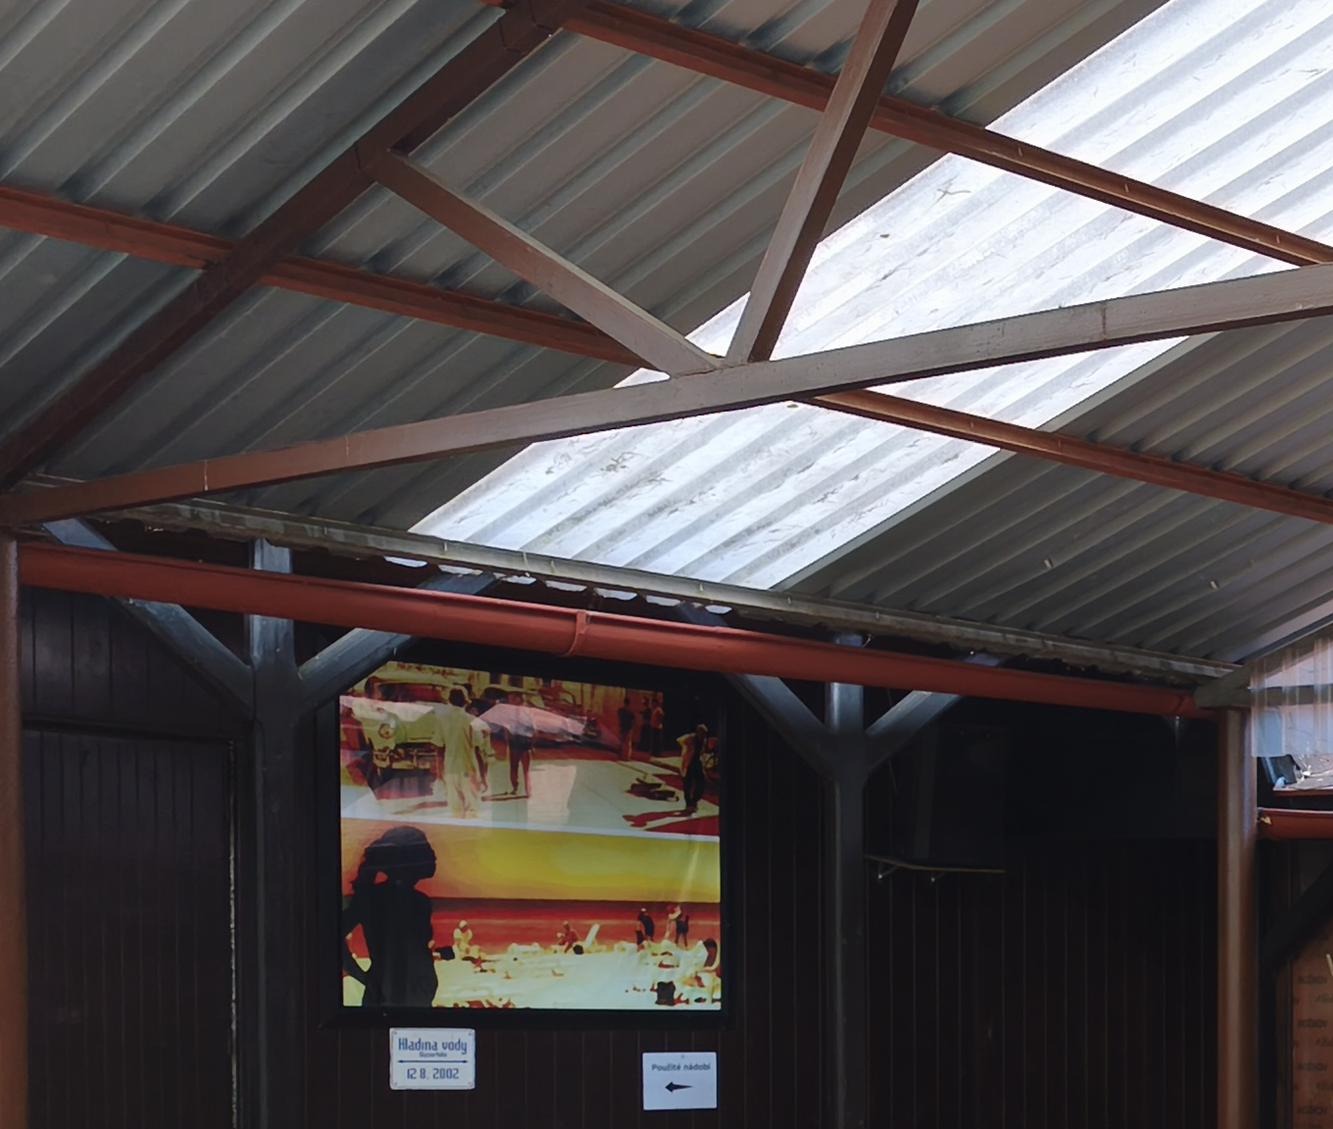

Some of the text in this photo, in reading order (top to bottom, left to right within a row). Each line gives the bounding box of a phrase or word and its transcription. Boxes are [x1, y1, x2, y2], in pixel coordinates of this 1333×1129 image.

[398, 1037, 438, 1051] Hladina
[442, 1038, 468, 1055] vody
[432, 1067, 460, 1080] 2002
